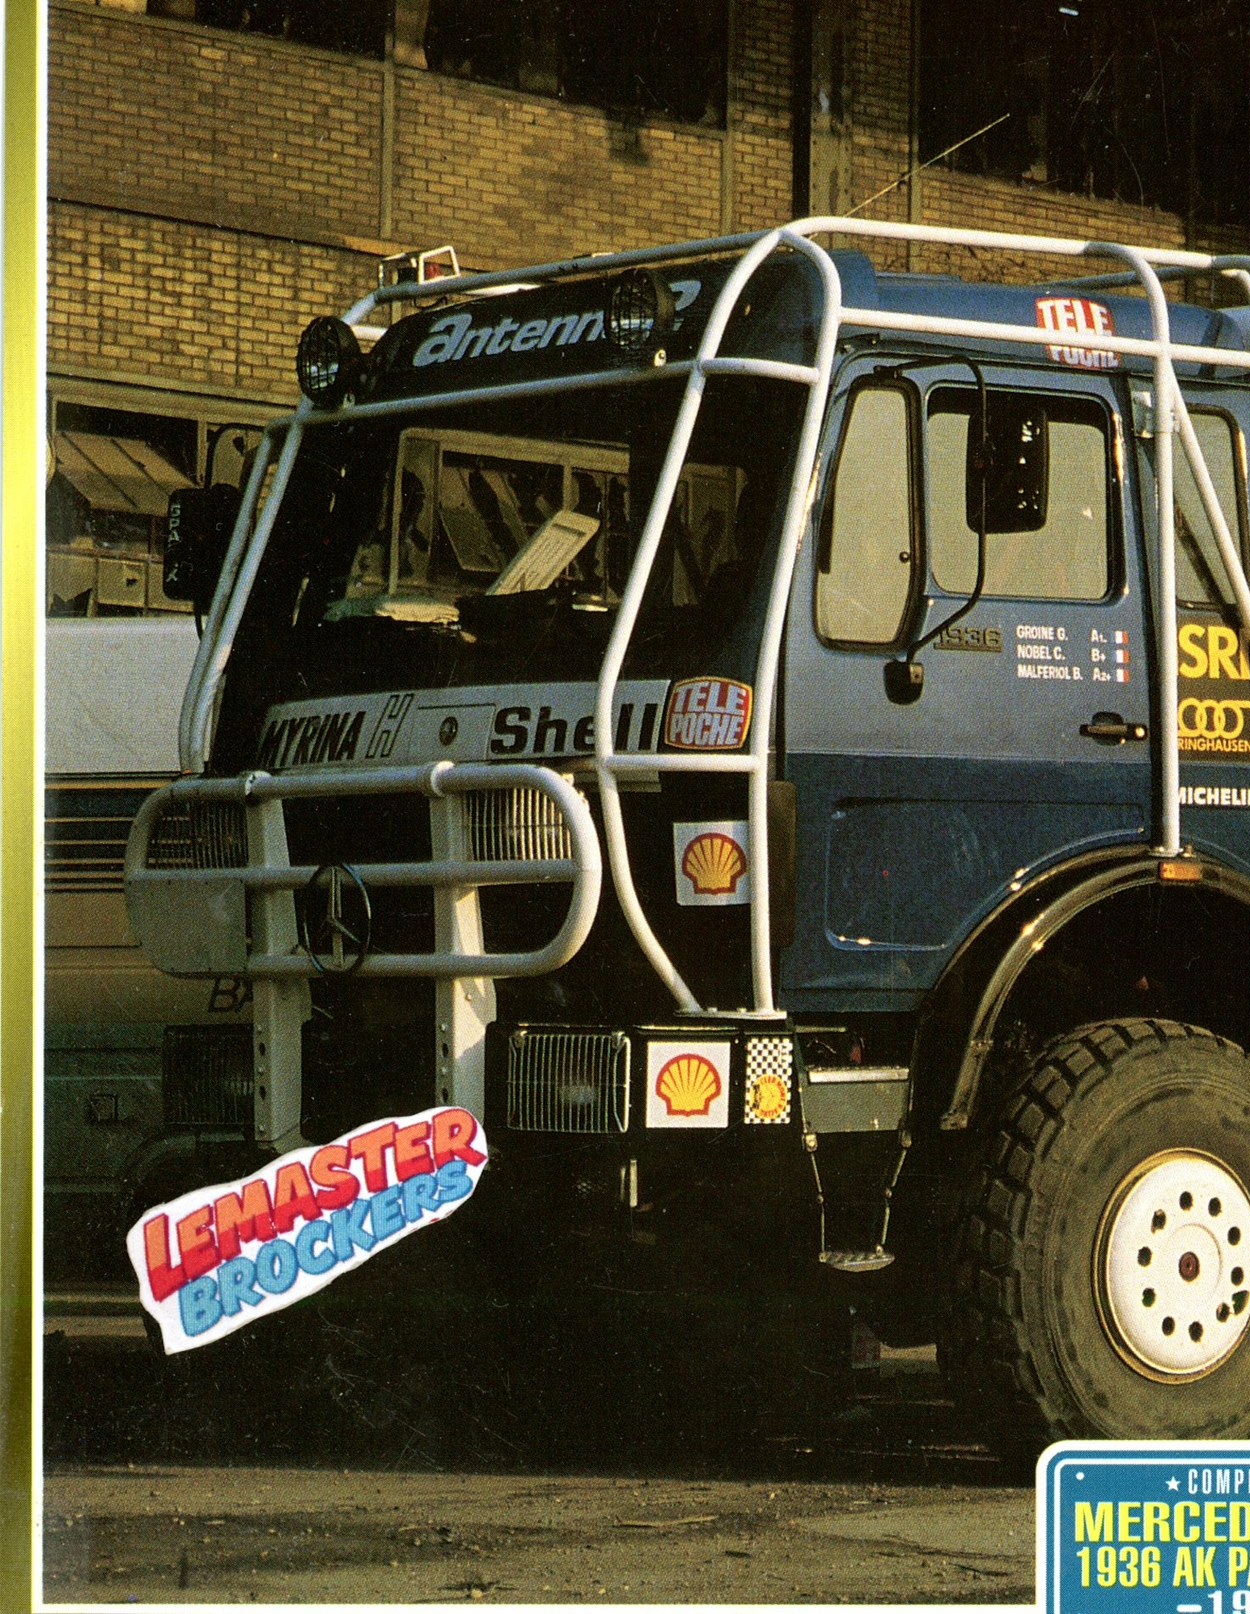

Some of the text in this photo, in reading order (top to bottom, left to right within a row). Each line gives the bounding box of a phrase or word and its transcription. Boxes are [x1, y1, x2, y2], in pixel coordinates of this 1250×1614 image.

[1037, 299, 1112, 337] TELE
[934, 627, 1001, 648] 1936
[1016, 625, 1054, 640] GROINE
[1057, 626, 1068, 641] G.
[1017, 645, 1106, 662] NOBEL C. B+
[1017, 664, 1071, 680] MALFERIOL
[1072, 666, 1083, 680] B.
[675, 681, 750, 716] TELE
[256, 711, 366, 768] MYRINA
[490, 702, 658, 754] Shell
[670, 713, 746, 747] POCHE
